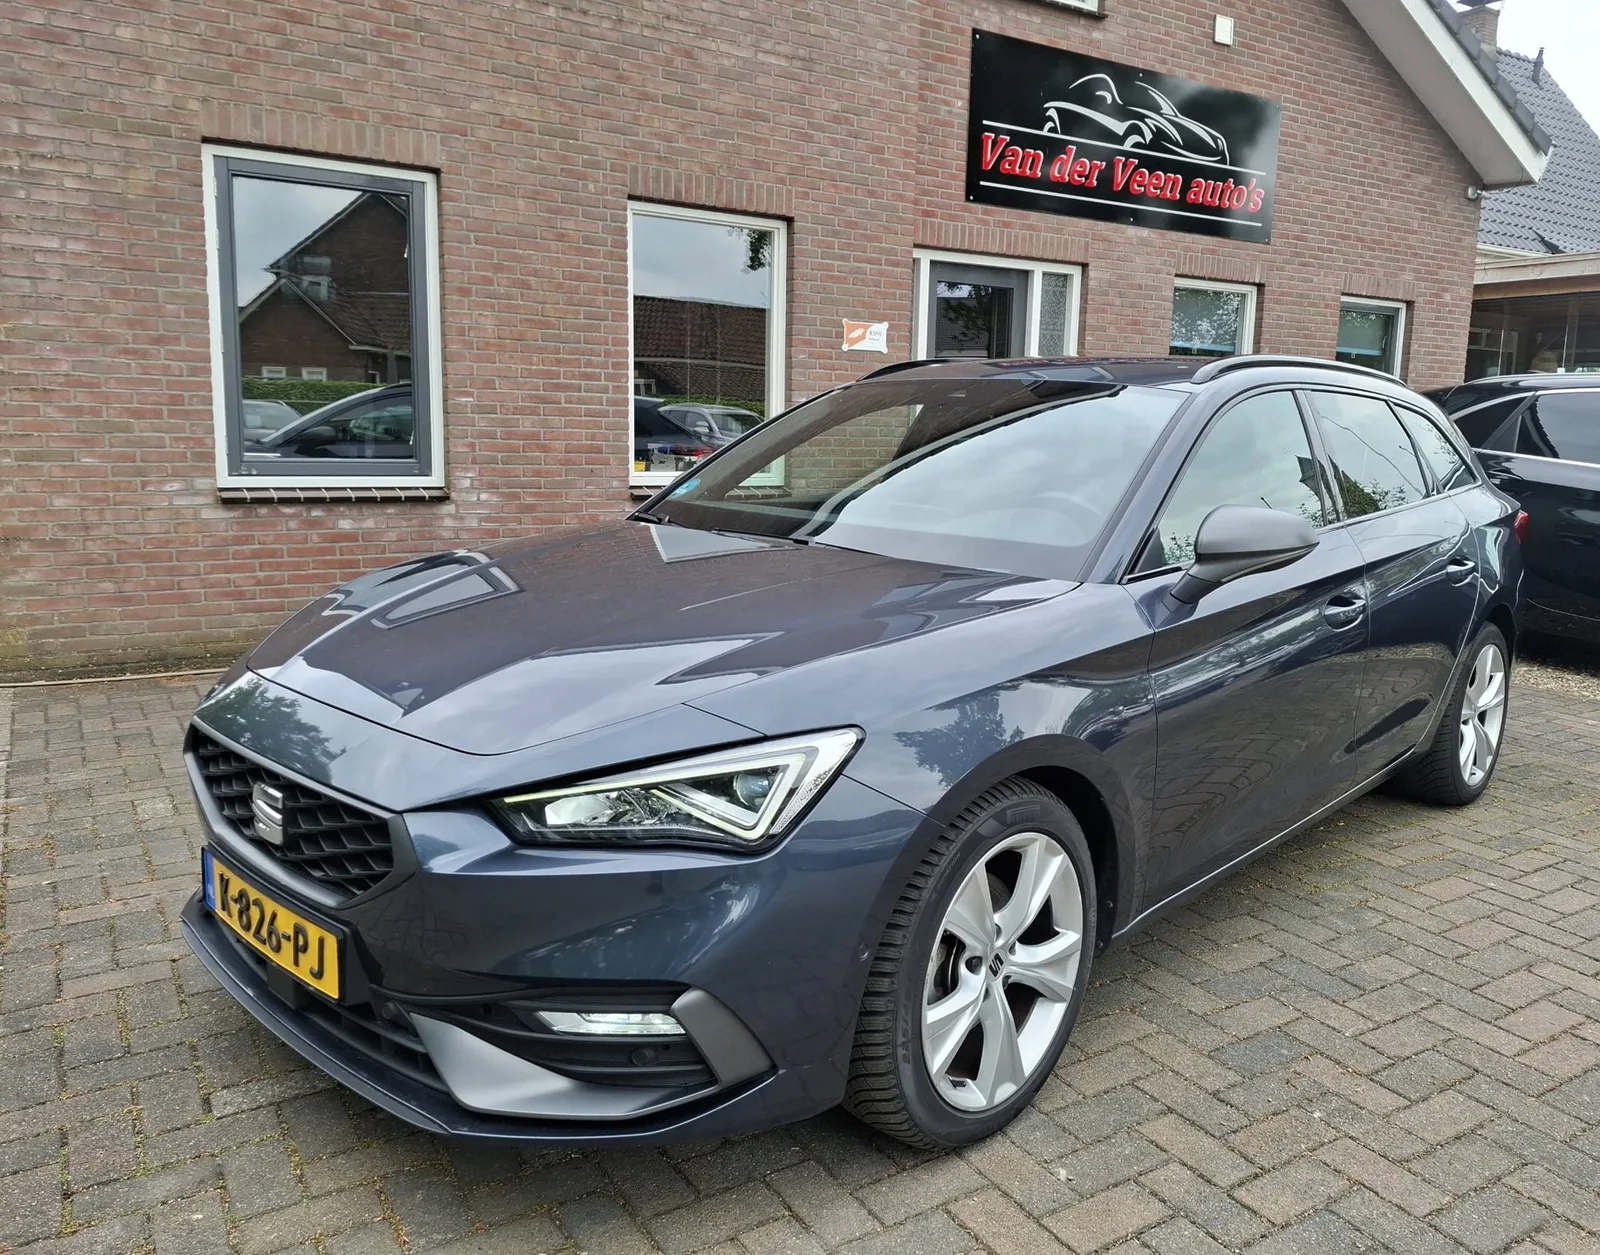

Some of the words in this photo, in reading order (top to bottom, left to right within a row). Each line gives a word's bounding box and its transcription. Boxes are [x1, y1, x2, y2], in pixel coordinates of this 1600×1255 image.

[981, 132, 1043, 179] Van
[1050, 145, 1105, 187] der
[1112, 156, 1182, 201] Veen
[1187, 178, 1266, 214] auto's
[218, 870, 325, 980] K-826-PJ
